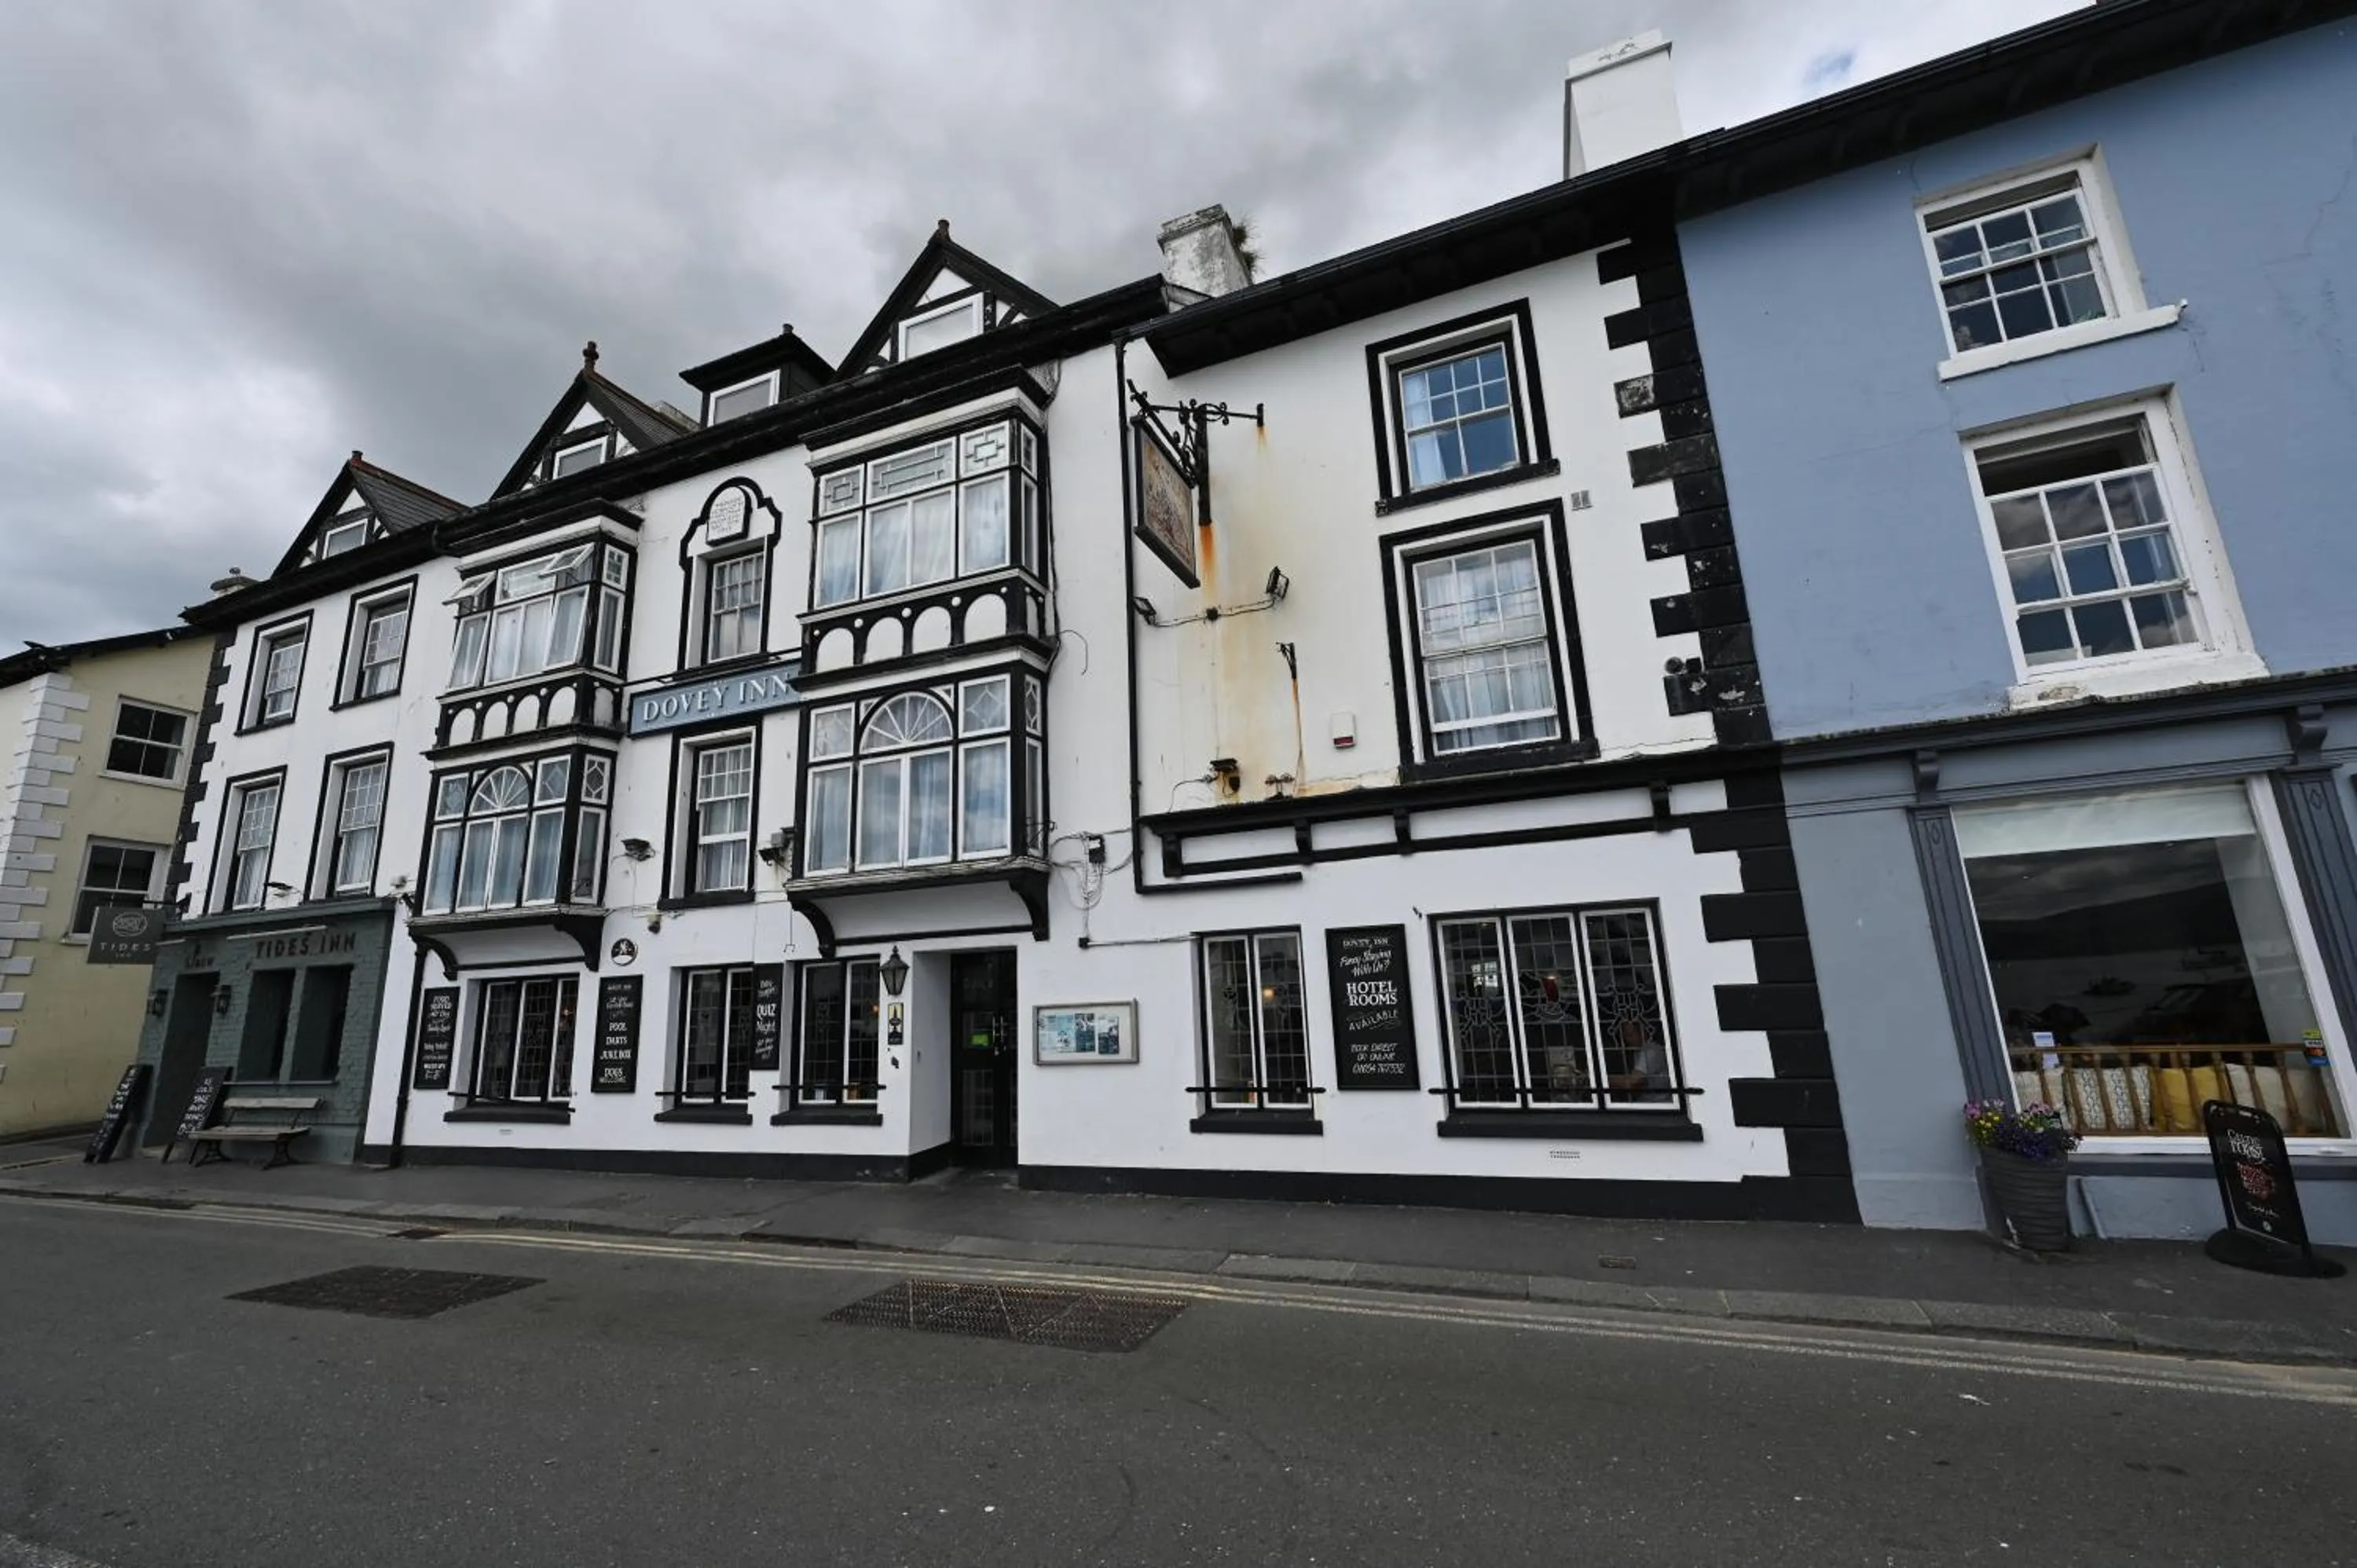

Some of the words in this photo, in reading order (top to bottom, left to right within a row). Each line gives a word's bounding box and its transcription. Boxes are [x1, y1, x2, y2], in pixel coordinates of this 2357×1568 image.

[643, 685, 729, 724] DOVEY
[739, 672, 791, 704] INN
[101, 942, 152, 952] TIDES
[256, 937, 309, 958] TIDES
[320, 932, 356, 954] INN
[1346, 980, 1398, 995] HOTEL
[1349, 992, 1398, 1006] ROOMS
[757, 1003, 776, 1020] QUIZ
[609, 1022, 628, 1032] POOL
[1349, 1009, 1398, 1031] AVAILABLE
[606, 1037, 628, 1046] DARTS
[604, 1068, 624, 1079] DOGS
